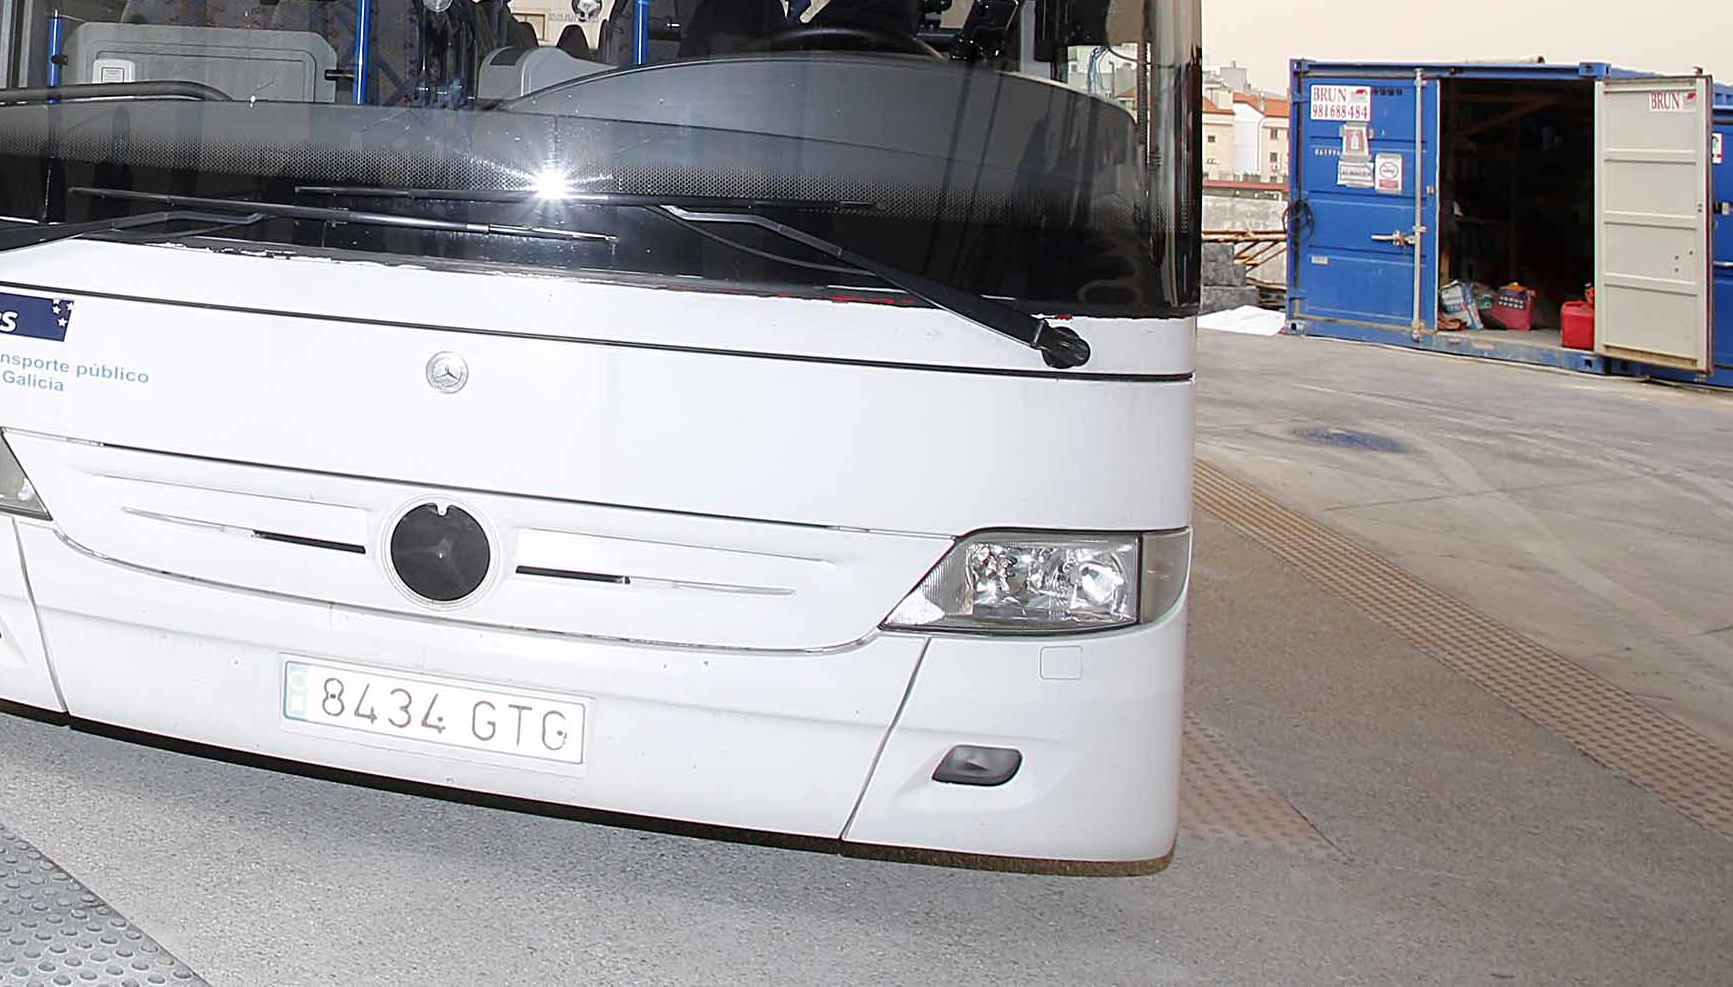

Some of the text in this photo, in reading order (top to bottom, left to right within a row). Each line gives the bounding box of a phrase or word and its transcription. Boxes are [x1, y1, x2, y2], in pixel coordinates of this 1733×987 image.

[1313, 87, 1347, 103] BRUN
[1650, 92, 1680, 110] BRUN
[3, 370, 65, 392] Galicia
[76, 362, 149, 384] público
[322, 677, 568, 751] 8434 GTG
